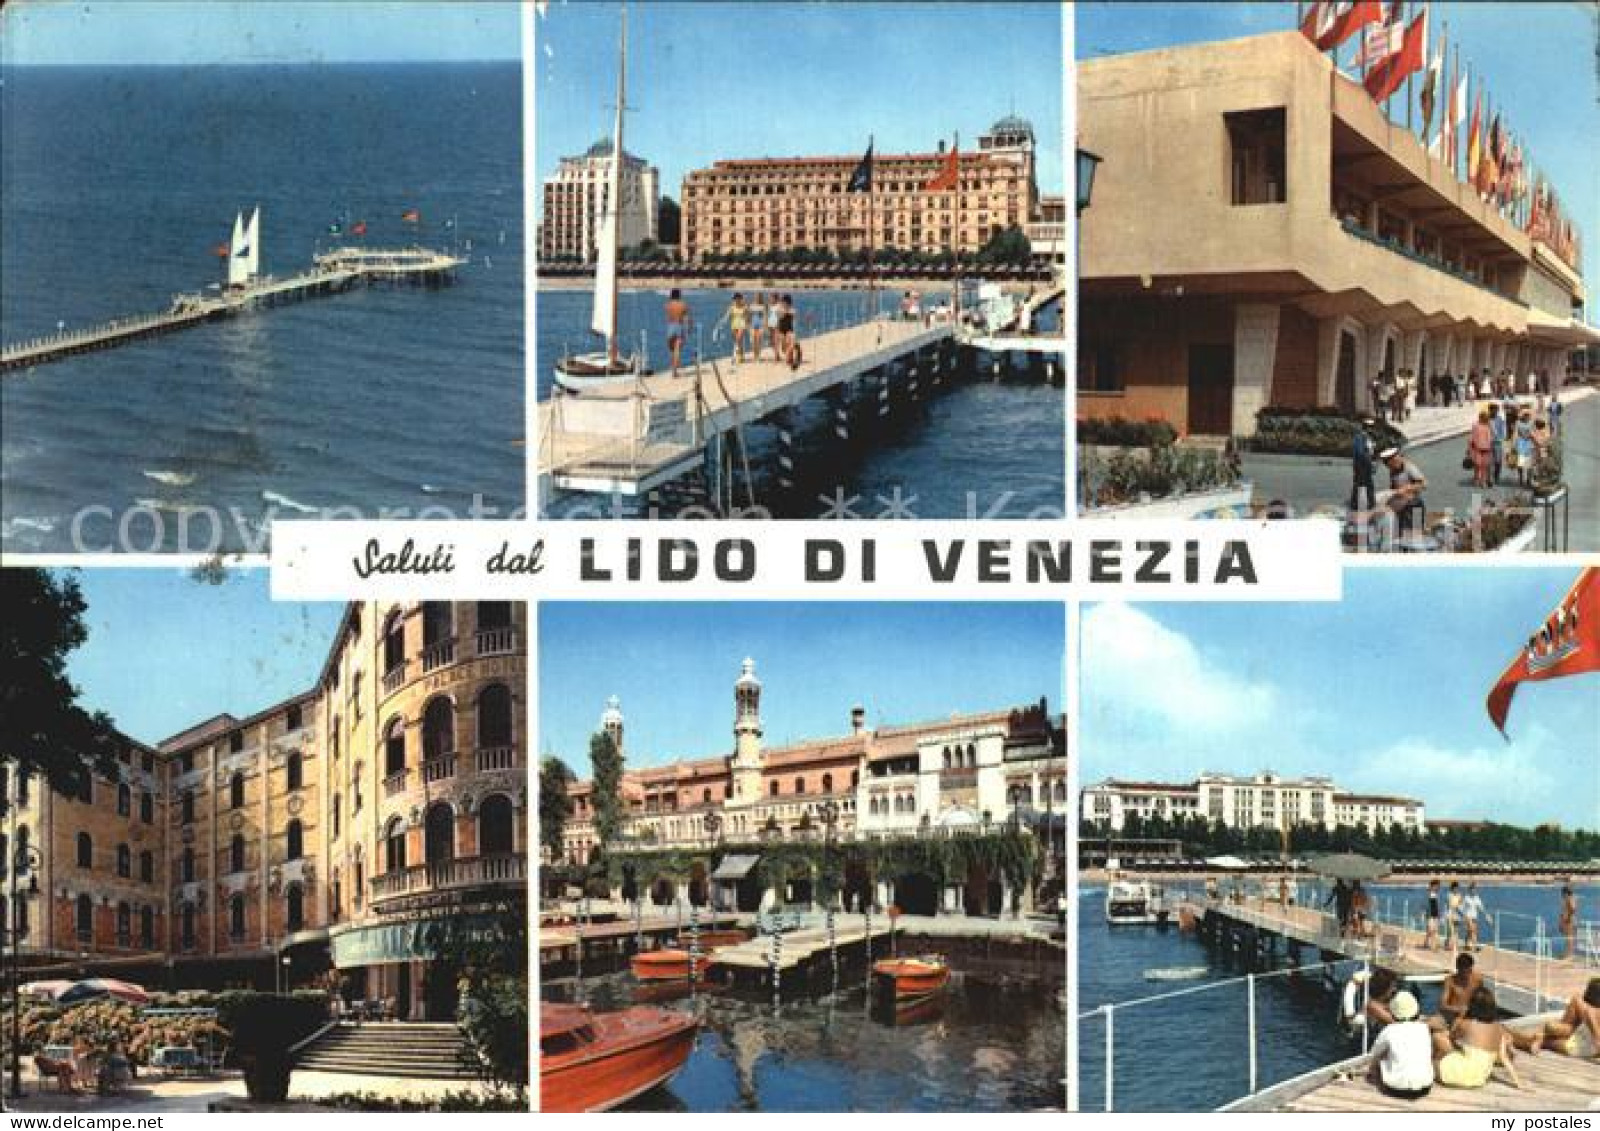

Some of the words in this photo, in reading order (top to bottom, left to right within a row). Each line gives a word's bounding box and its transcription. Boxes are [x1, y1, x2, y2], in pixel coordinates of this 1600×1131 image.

[353, 538, 454, 579] Saluti
[486, 539, 544, 574] dal
[580, 538, 755, 582] LIDO
[804, 539, 876, 582] DI
[921, 540, 1258, 584] VENEZIA
